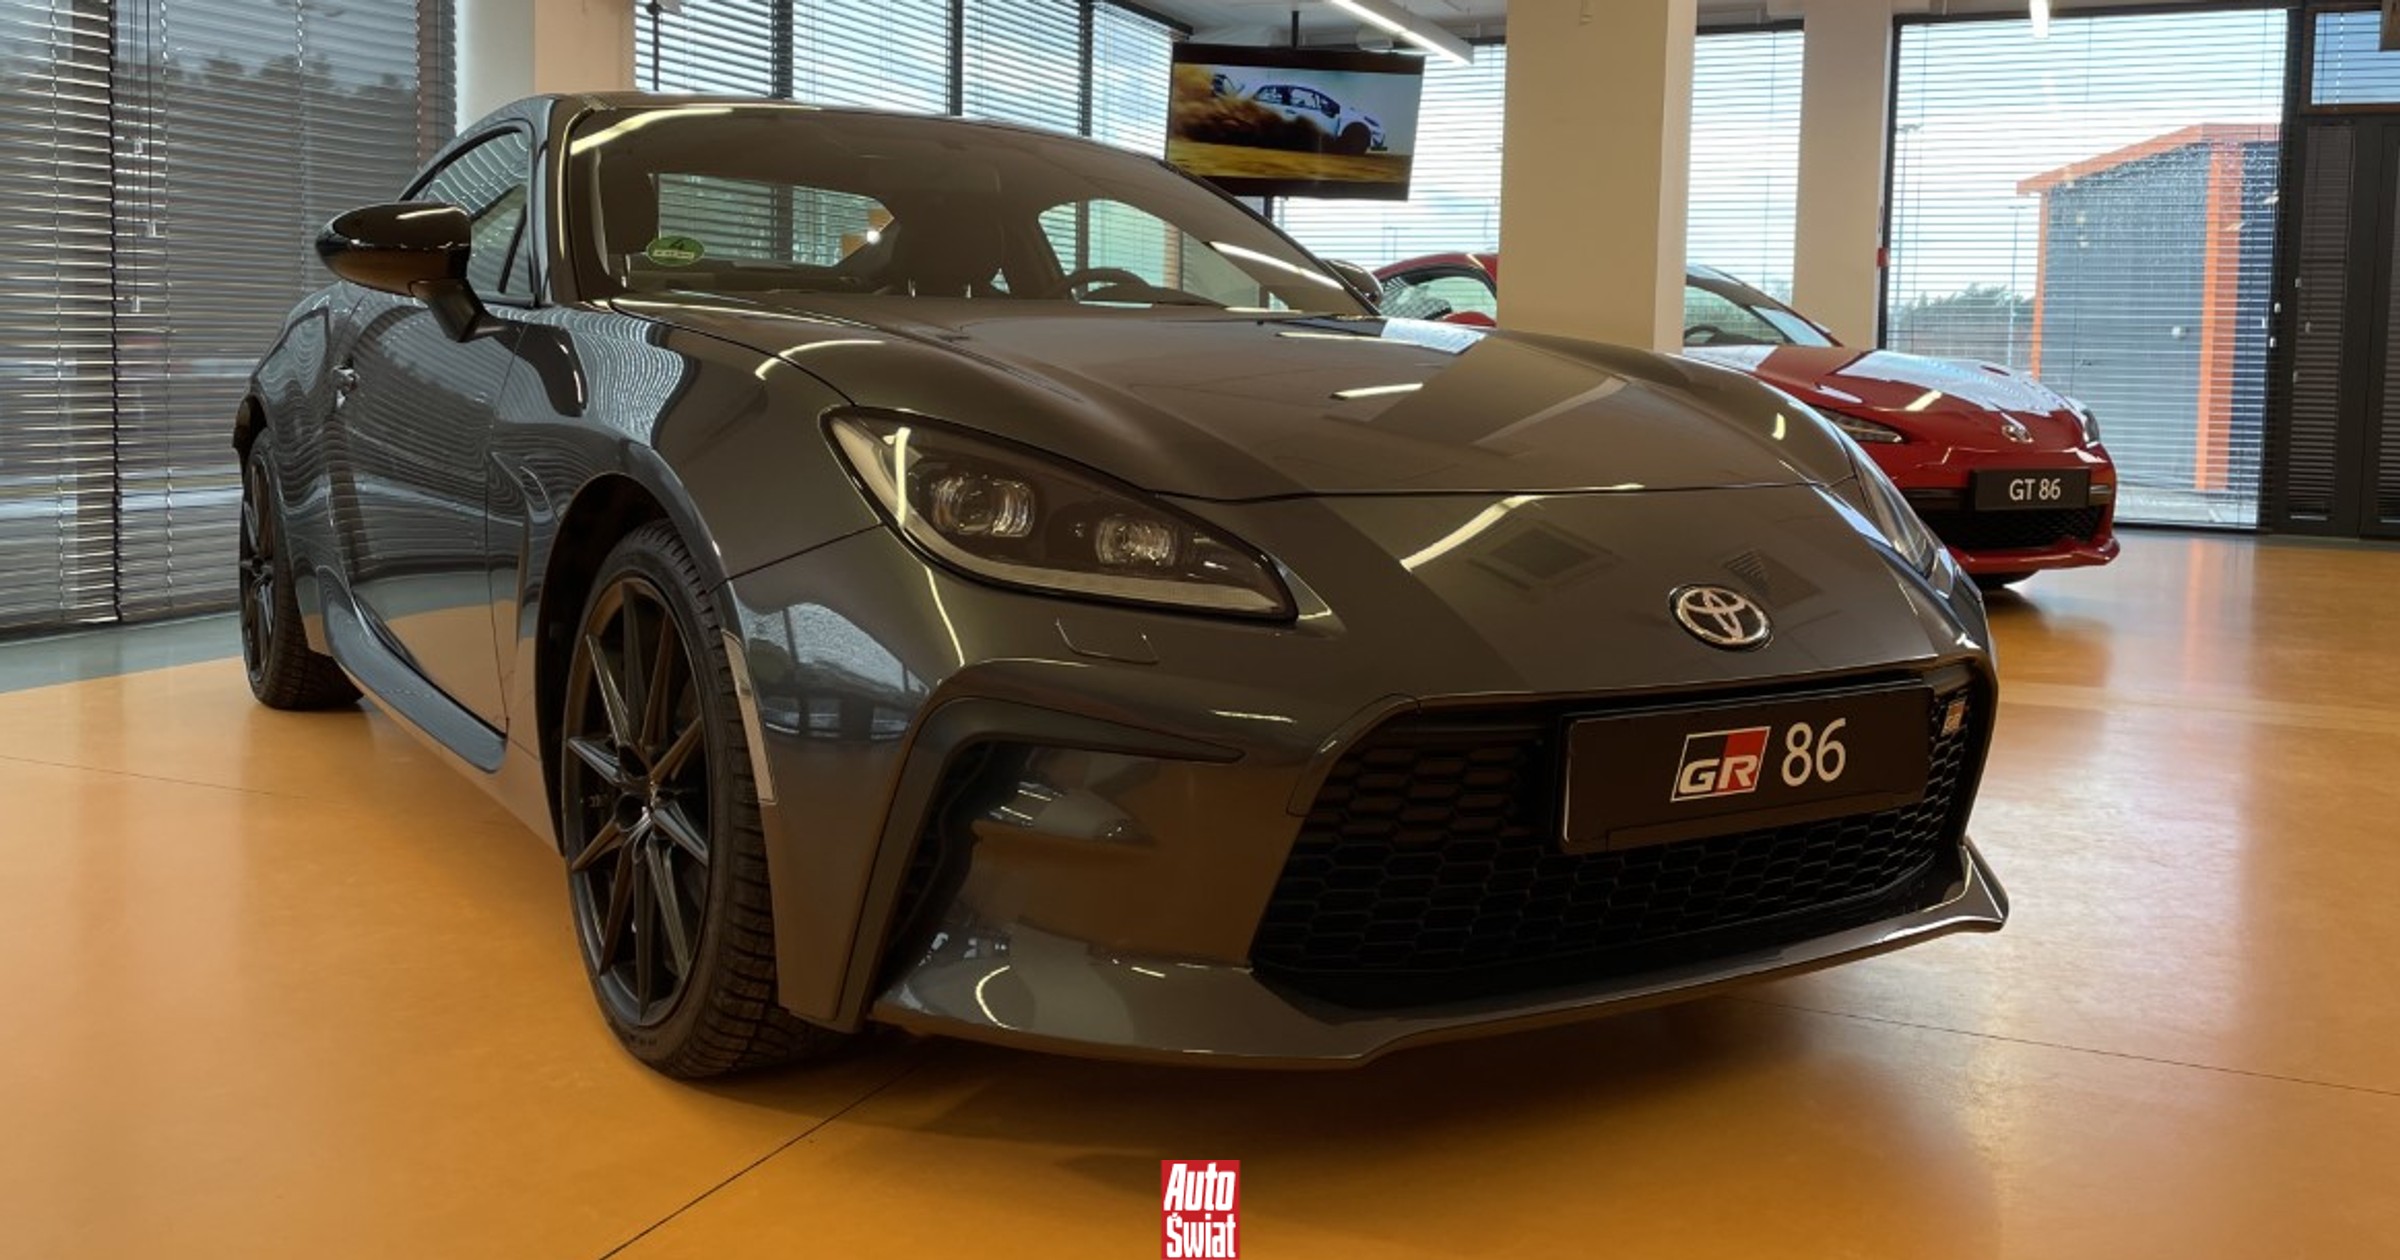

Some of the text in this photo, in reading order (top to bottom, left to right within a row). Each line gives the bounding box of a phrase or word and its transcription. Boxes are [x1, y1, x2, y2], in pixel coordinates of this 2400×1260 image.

[2009, 478, 2061, 501] GT 86
[1678, 717, 1847, 794] GR 86
